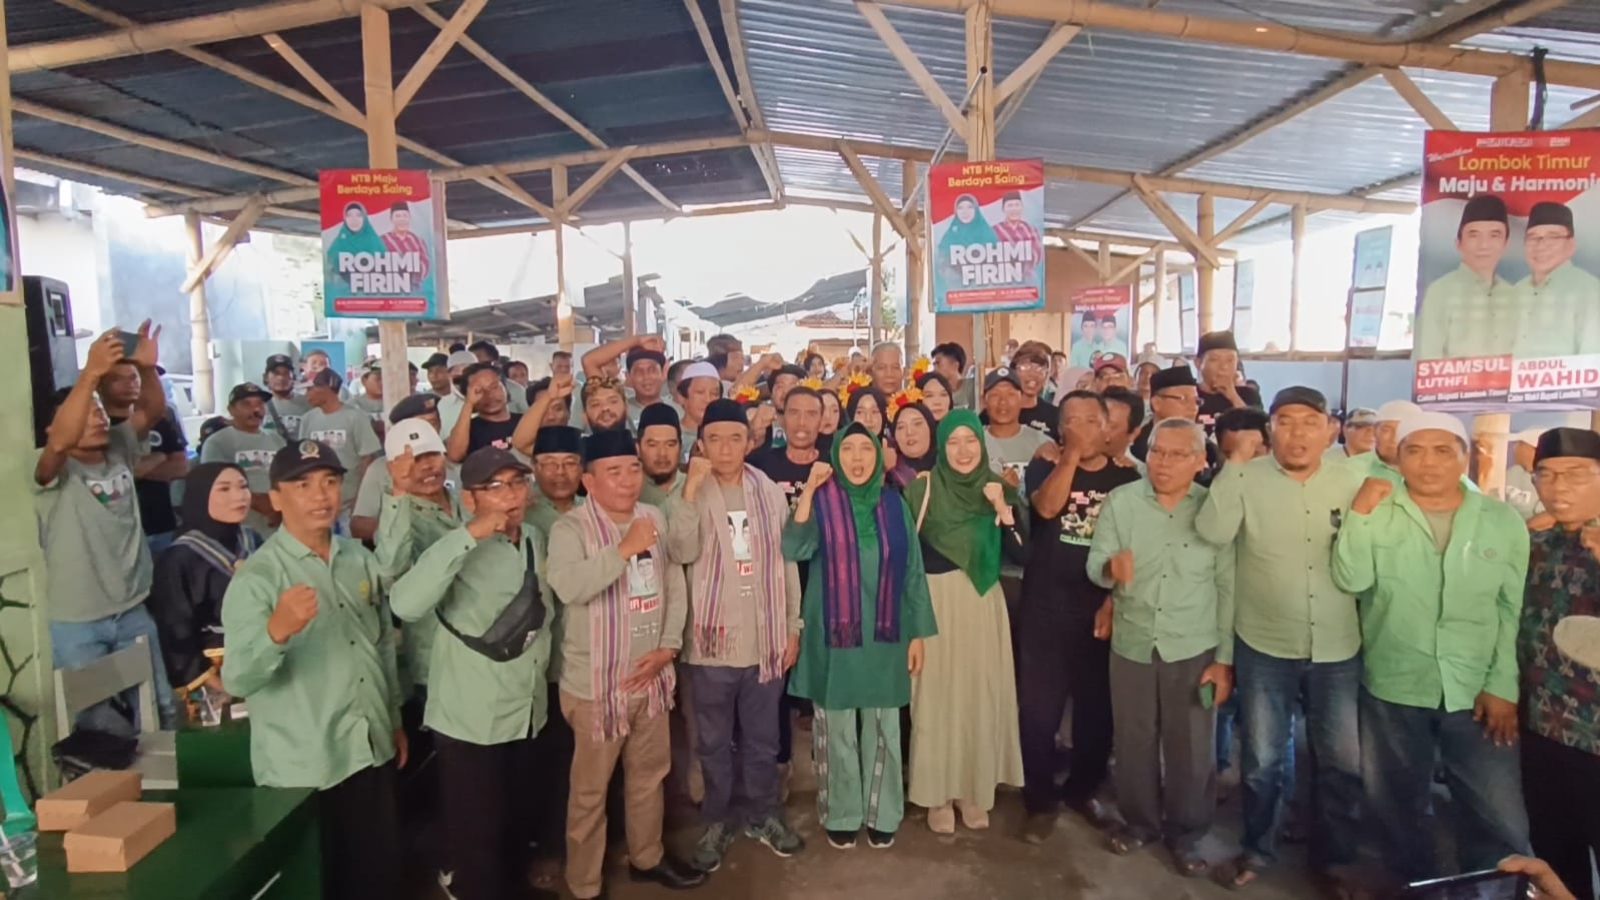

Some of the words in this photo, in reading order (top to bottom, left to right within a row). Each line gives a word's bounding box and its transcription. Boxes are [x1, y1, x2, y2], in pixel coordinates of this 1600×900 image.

[962, 165, 982, 175] NTB
[984, 164, 1010, 175] Maju
[1459, 155, 1532, 171] Lombok
[1536, 154, 1591, 170] Timur
[351, 174, 371, 183] NTB
[373, 174, 398, 185] Maju
[948, 176, 992, 188] Berdaya
[994, 174, 1025, 185] Saing
[1439, 174, 1488, 198] Maju
[1491, 176, 1506, 192] &
[337, 185, 381, 195] Berdaya
[382, 185, 413, 195] Saing
[950, 240, 1032, 265] ROHMI
[338, 252, 420, 273] ROHMI
[350, 272, 411, 293] FIRIN
[961, 262, 1023, 286] FIRIN
[1418, 358, 1510, 377] SYAMSUL
[1517, 359, 1568, 371] ABDUL
[1416, 375, 1468, 389] LUTHFI
[1517, 368, 1599, 389] WAHID
